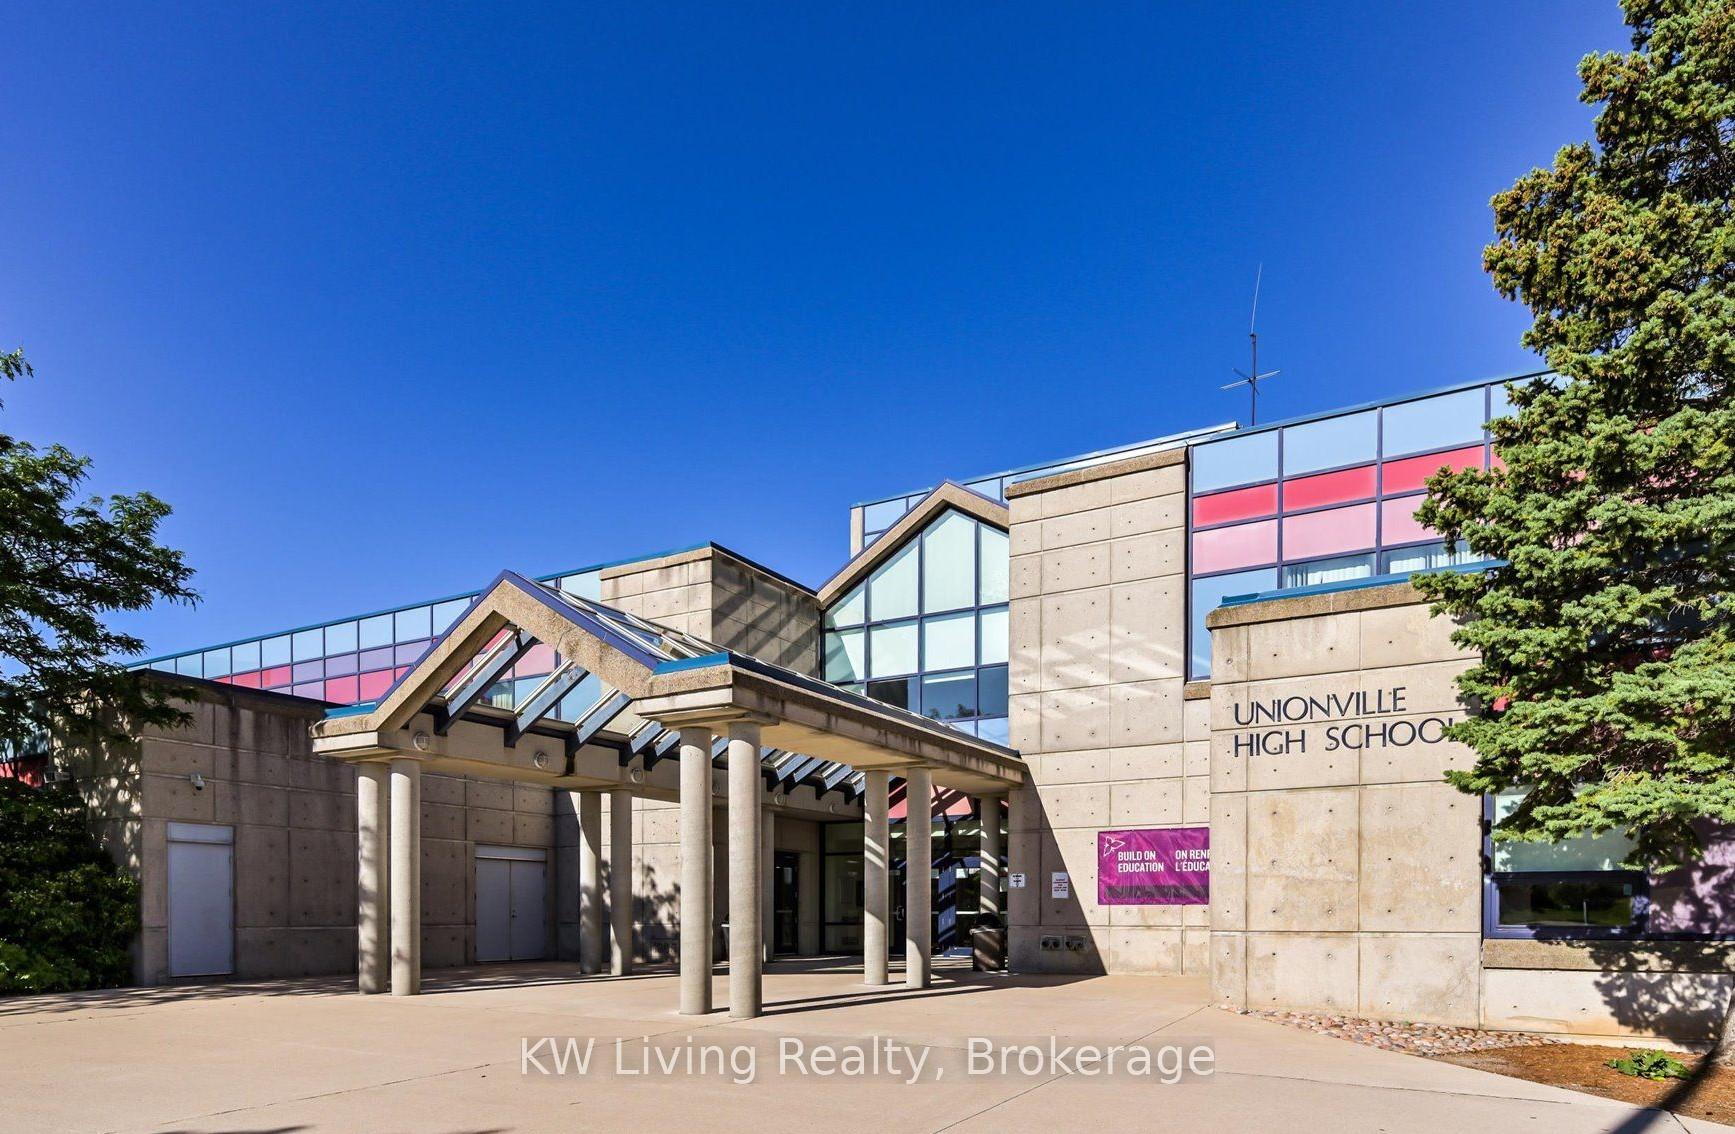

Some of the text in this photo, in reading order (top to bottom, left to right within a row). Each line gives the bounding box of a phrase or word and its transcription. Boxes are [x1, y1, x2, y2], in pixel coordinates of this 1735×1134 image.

[1234, 686, 1407, 726] UNIONVILLE
[1234, 729, 1306, 758] HIGH
[1118, 850, 1156, 862] BUILD ON
[1175, 849, 1188, 860] ON
[1118, 862, 1164, 873] EDUCATION
